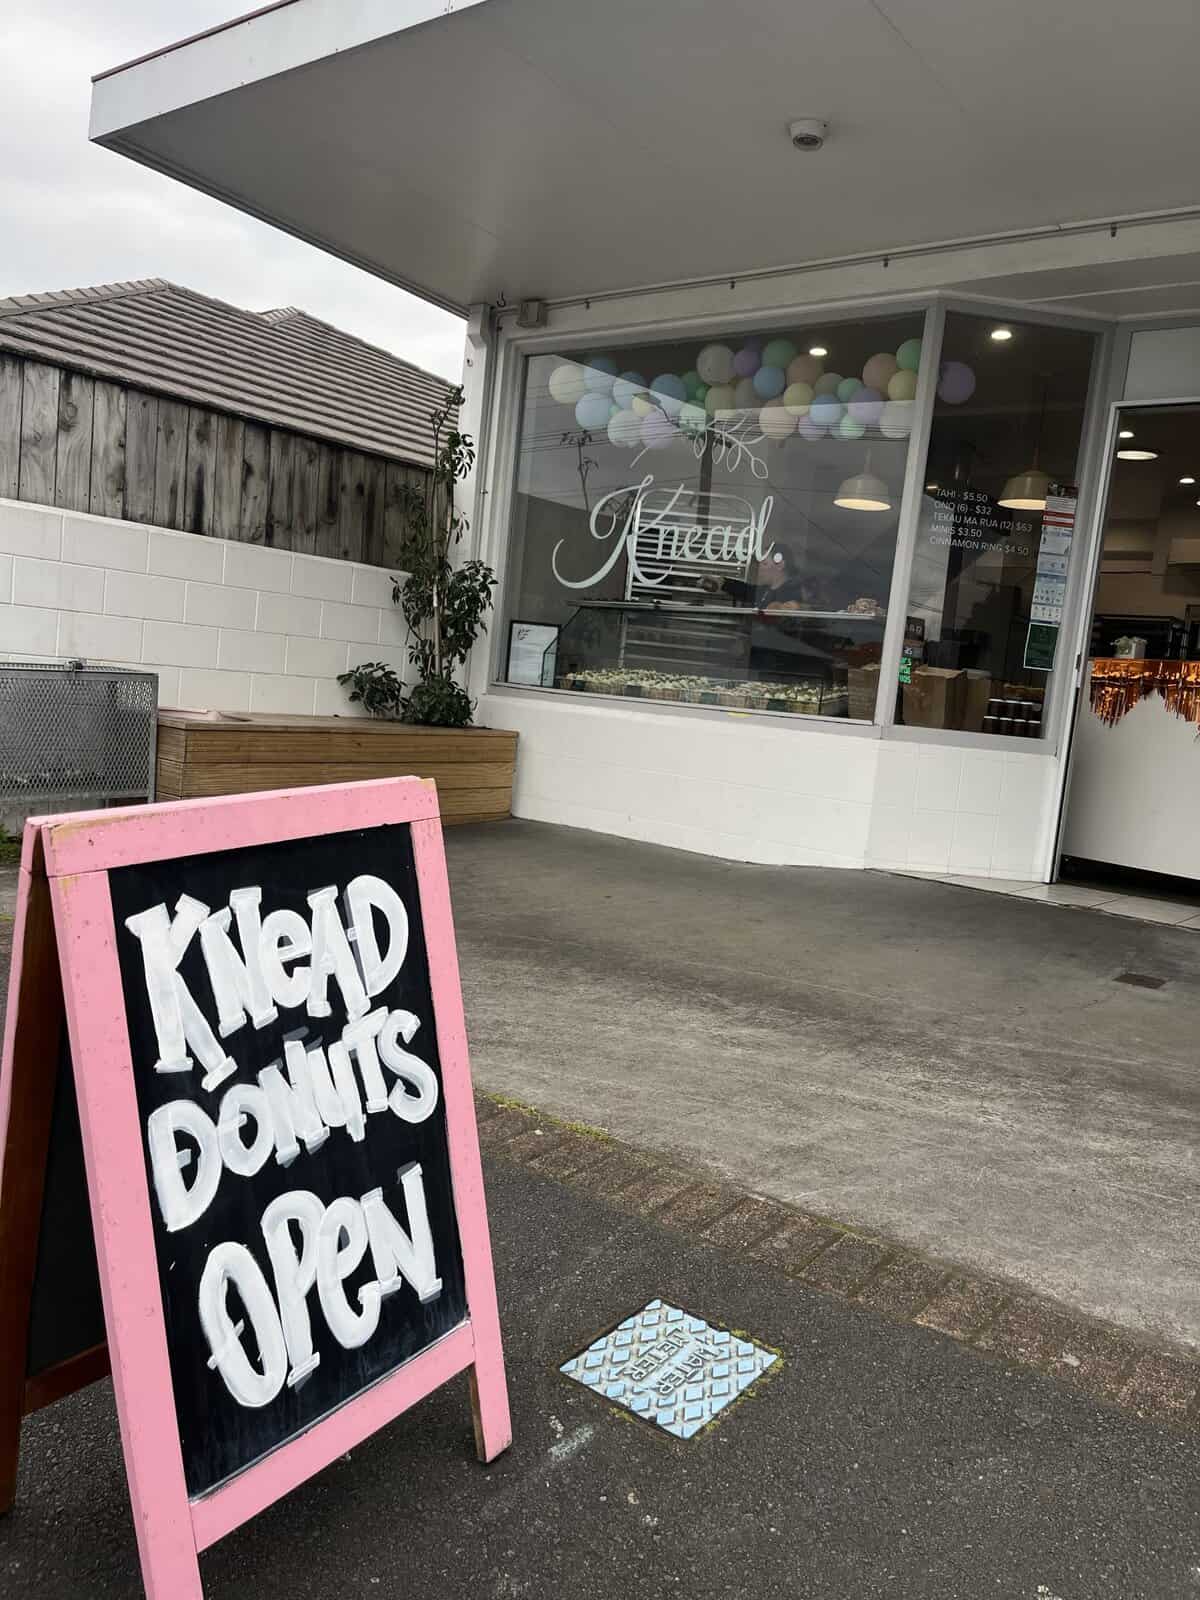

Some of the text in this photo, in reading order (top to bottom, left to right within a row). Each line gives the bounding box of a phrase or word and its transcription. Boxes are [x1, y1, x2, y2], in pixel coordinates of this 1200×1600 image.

[936, 488, 956, 498] TAHI
[963, 491, 988, 503] $5.50
[934, 500, 955, 511] ONO
[957, 503, 968, 514] (6)
[975, 505, 993, 516] $32
[934, 511, 962, 523] TEKAU
[980, 518, 998, 528] RUA
[1000, 520, 1014, 531] (12)
[957, 527, 982, 538] $3.50
[929, 535, 979, 550] CINNAMON
[981, 542, 1002, 552] RING
[623, 1331, 690, 1380] METER
[655, 1346, 724, 1395] WATER
